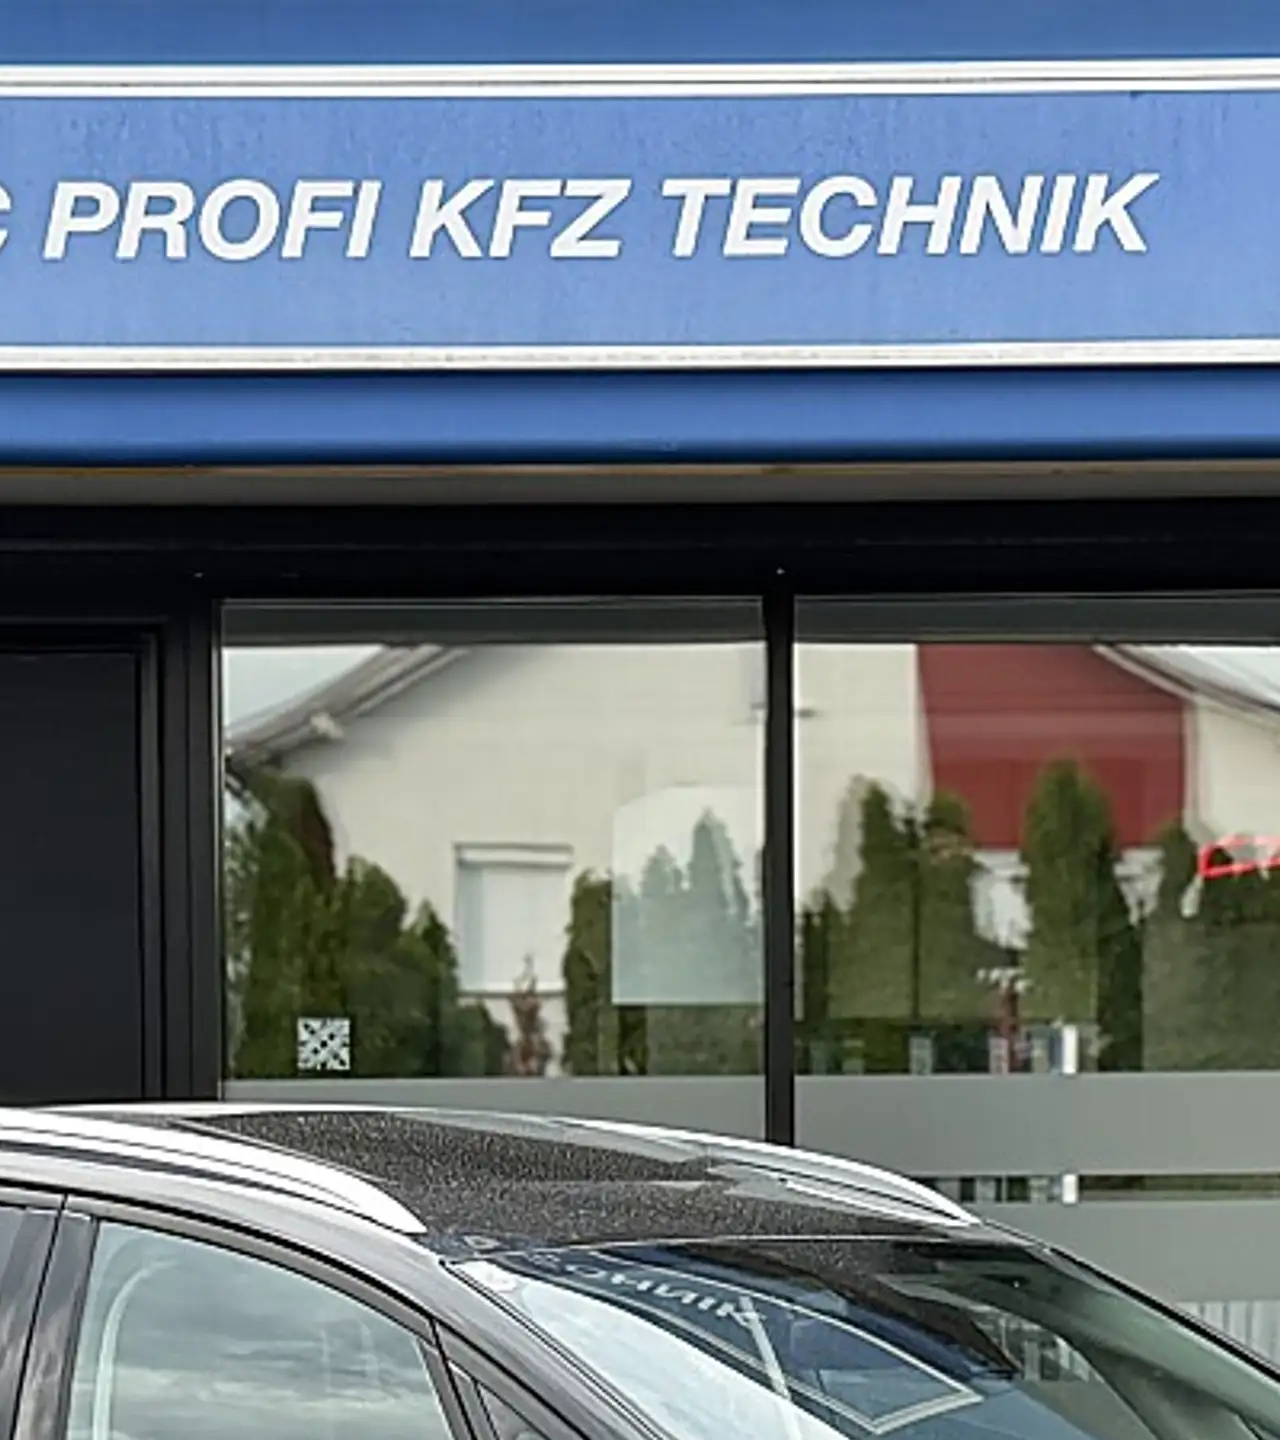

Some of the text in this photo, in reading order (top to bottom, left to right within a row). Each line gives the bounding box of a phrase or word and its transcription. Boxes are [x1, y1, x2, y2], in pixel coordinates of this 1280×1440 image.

[44, 179, 381, 260] PROFI
[409, 178, 632, 258] KFZ
[662, 173, 1159, 257] TECHNIK
